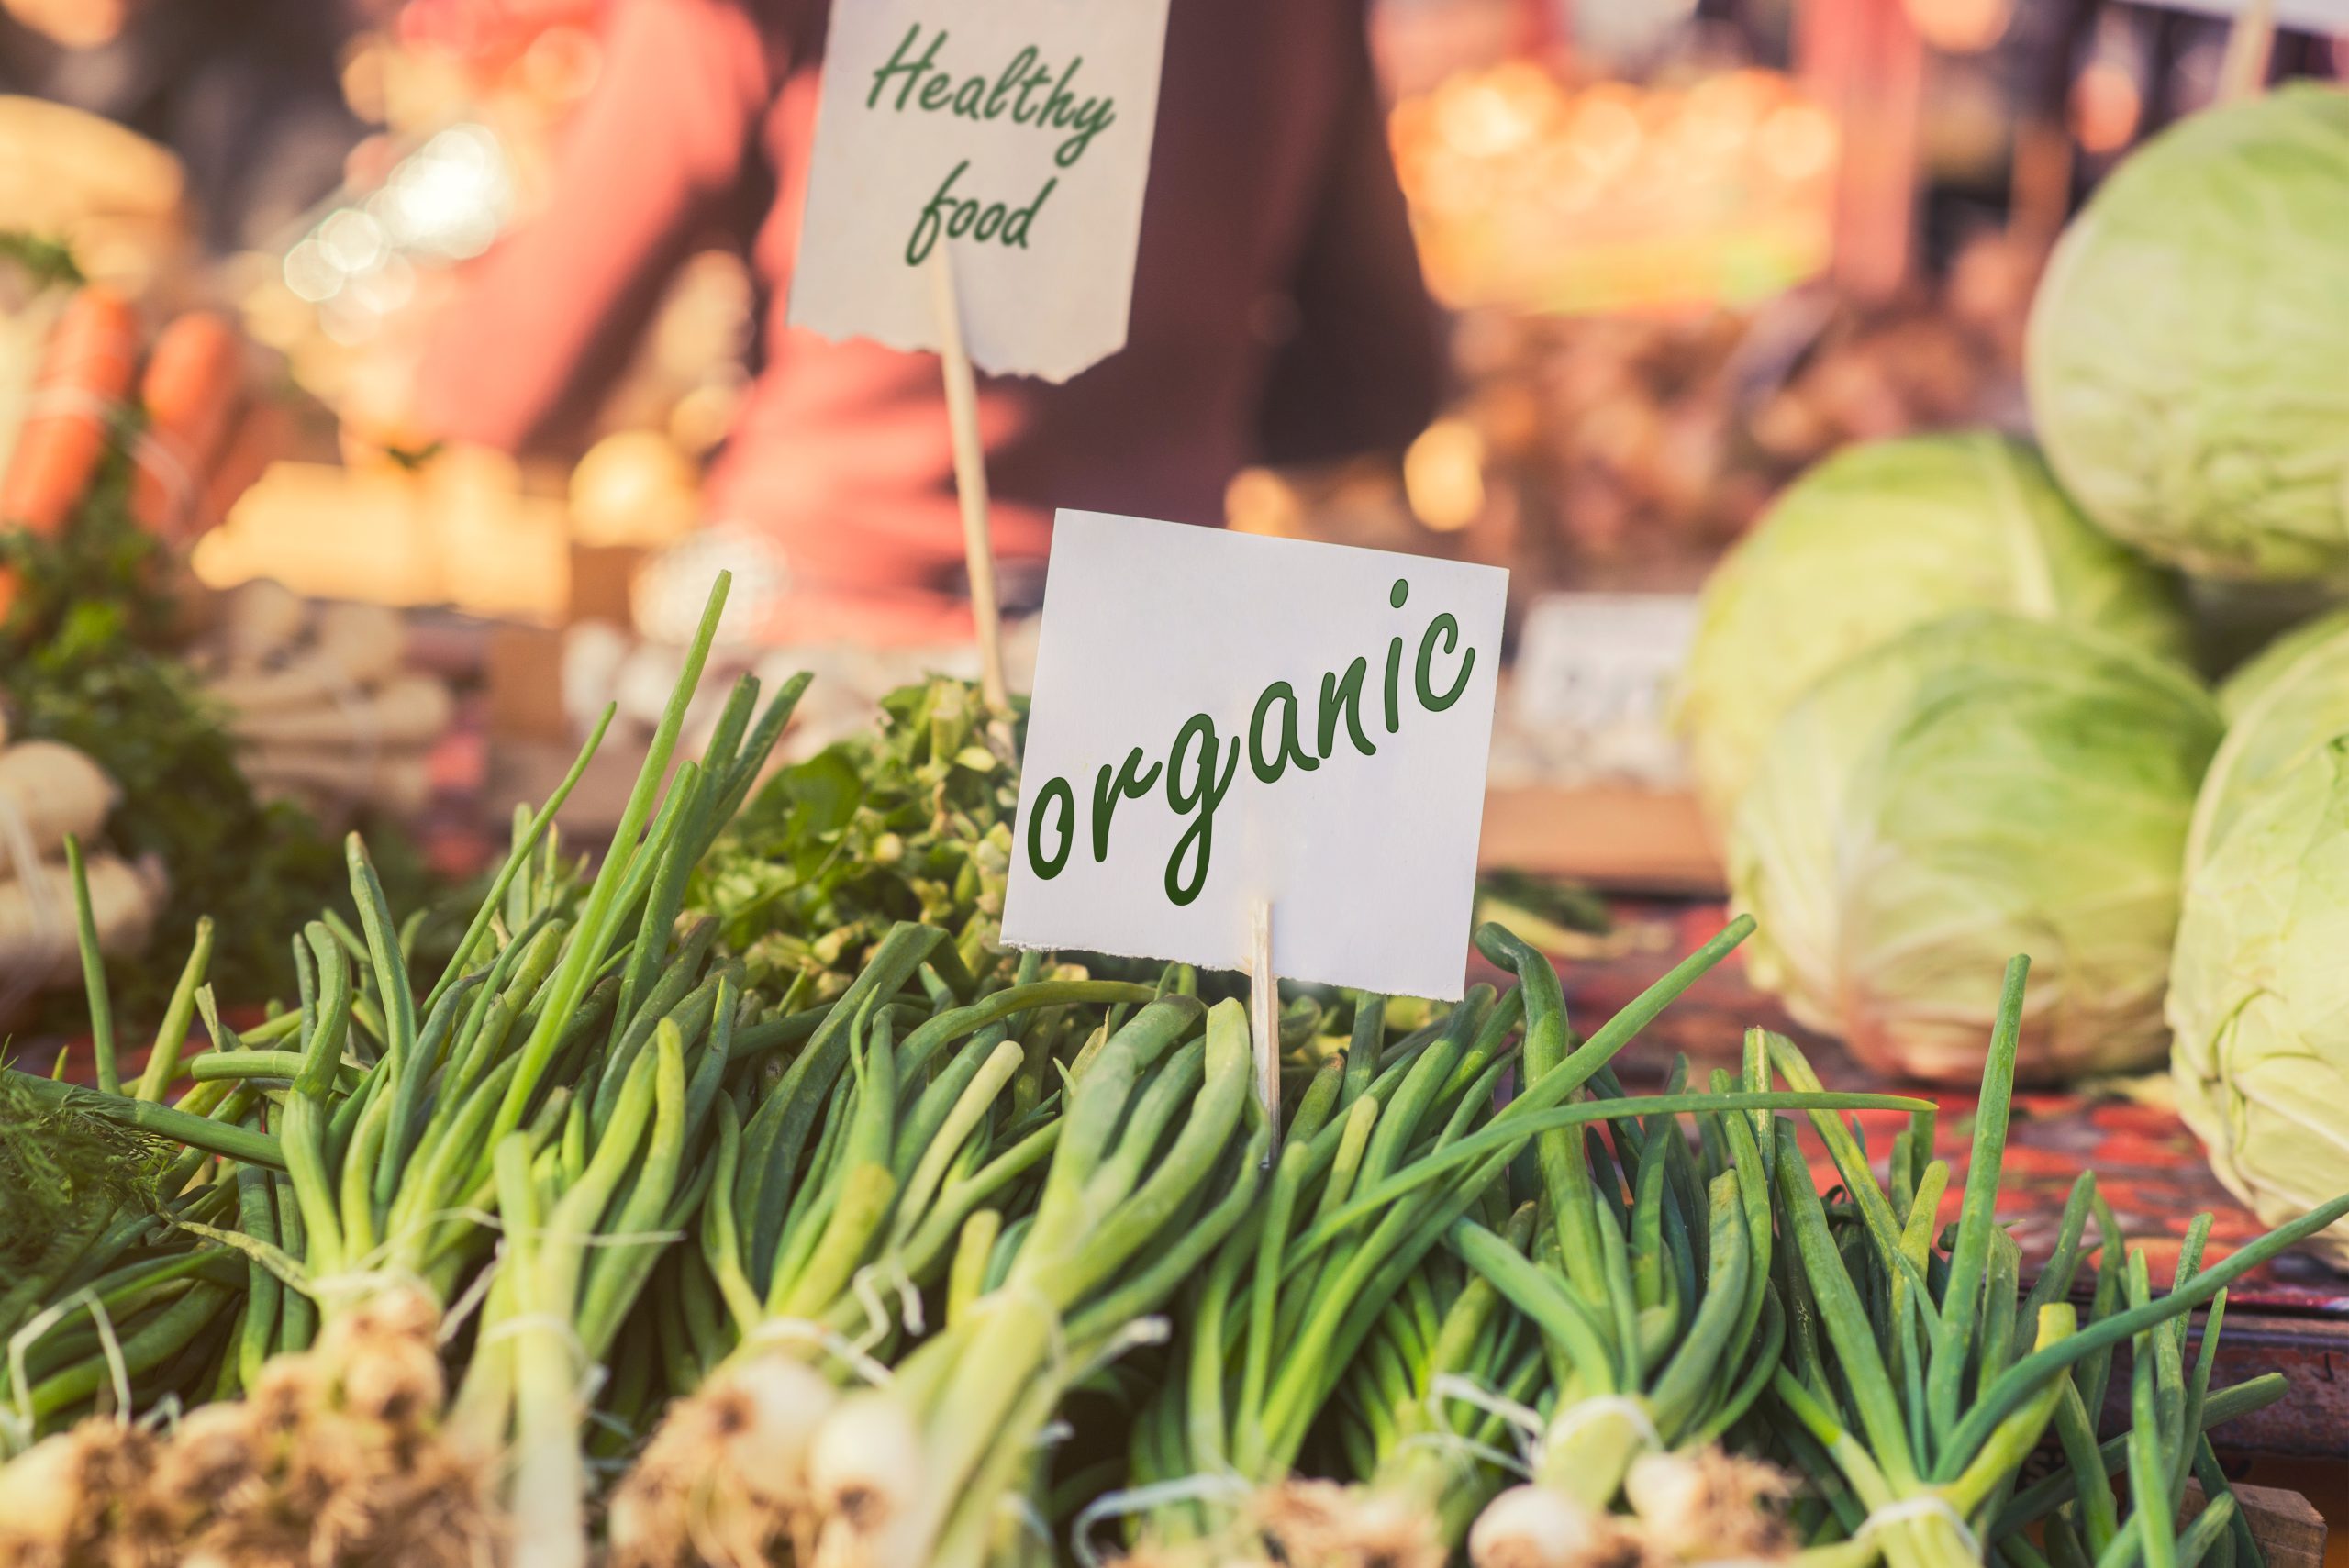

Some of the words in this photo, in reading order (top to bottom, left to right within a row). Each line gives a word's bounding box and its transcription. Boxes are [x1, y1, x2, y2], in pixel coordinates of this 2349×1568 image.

[866, 22, 1116, 169] Healthy
[905, 160, 1059, 267] food
[1026, 578, 1476, 907] organic
